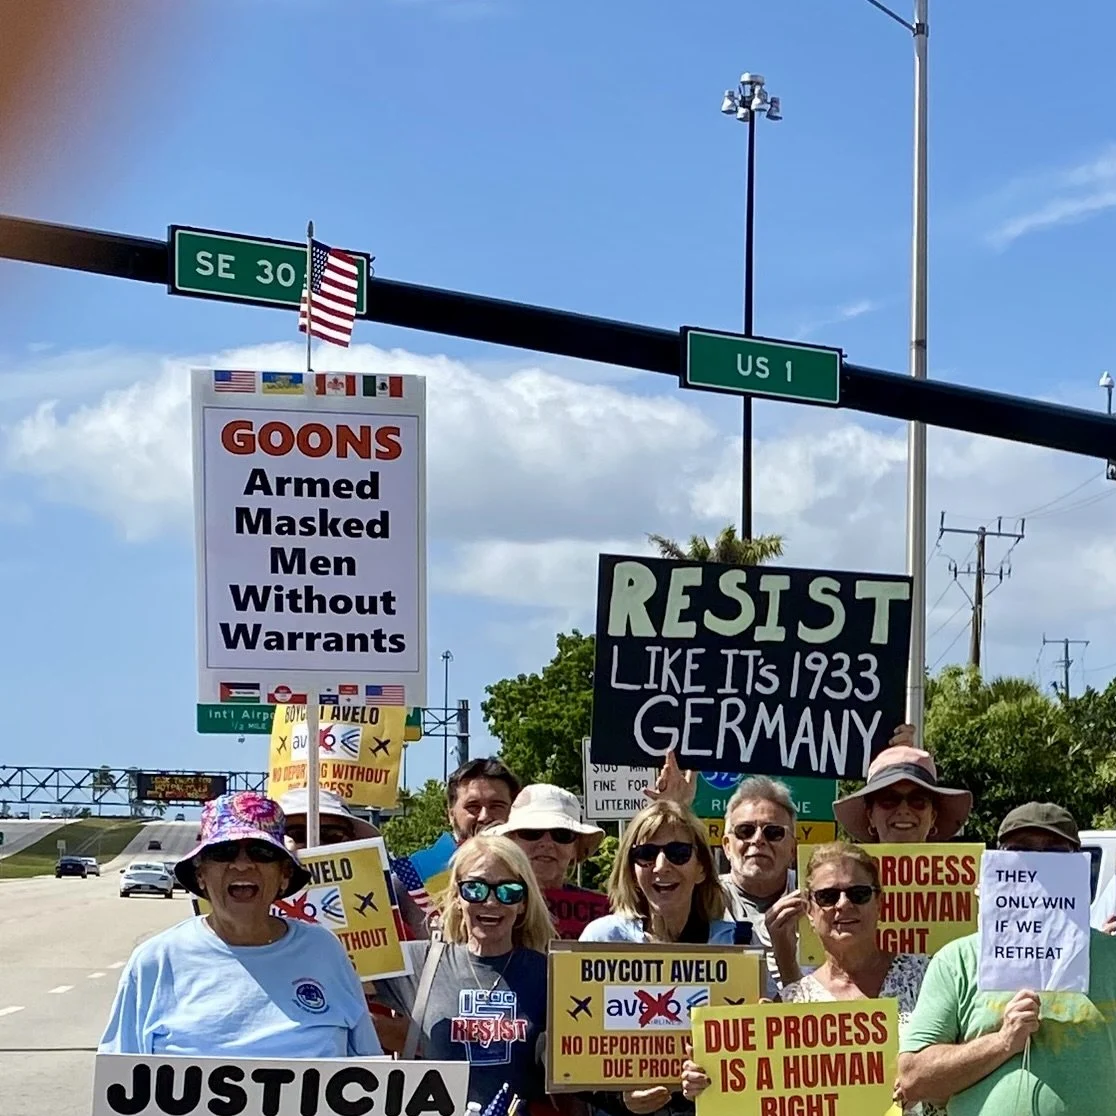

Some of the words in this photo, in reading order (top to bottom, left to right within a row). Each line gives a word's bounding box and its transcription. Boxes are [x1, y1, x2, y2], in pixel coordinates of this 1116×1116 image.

[196, 251, 235, 279] SE
[256, 259, 295, 287] 30
[736, 353, 769, 379] US
[785, 360, 792, 382] 1
[220, 420, 403, 460] GOONS
[243, 468, 380, 500] Armed
[234, 507, 391, 539] Masked
[269, 547, 357, 577] Men
[229, 584, 397, 616] Without
[607, 561, 910, 645] RESIST
[219, 623, 407, 654] Warrants
[610, 645, 706, 694] LIKE
[717, 649, 780, 695] IT's
[790, 650, 881, 702] 1933
[331, 705, 380, 725] AVELO
[633, 694, 882, 777] GERMANY
[332, 764, 391, 785] WITHOUT
[594, 780, 616, 791] FINE
[628, 780, 648, 791] FOR
[595, 799, 648, 811] LITTERING
[995, 870, 1037, 883] THEY
[880, 891, 972, 922] HUMAN
[995, 895, 1039, 910] ONLY
[1041, 896, 1076, 910] WIN
[876, 928, 929, 954] IGHT
[995, 920, 1009, 934] IF
[1016, 920, 1042, 934] WE
[994, 946, 1063, 960] RETREAT
[581, 959, 663, 983] BOYCOTT
[670, 960, 728, 982] AVELO
[450, 1016, 528, 1045] RESIST
[705, 1017, 756, 1054] DUE
[767, 1011, 888, 1050] PROCESS
[561, 1036, 583, 1056] NO
[588, 1035, 675, 1055] DEPORTING
[603, 1058, 633, 1078] DUE
[720, 1058, 746, 1093] IS
[756, 1057, 776, 1091] A
[783, 1051, 885, 1089] HUMAN
